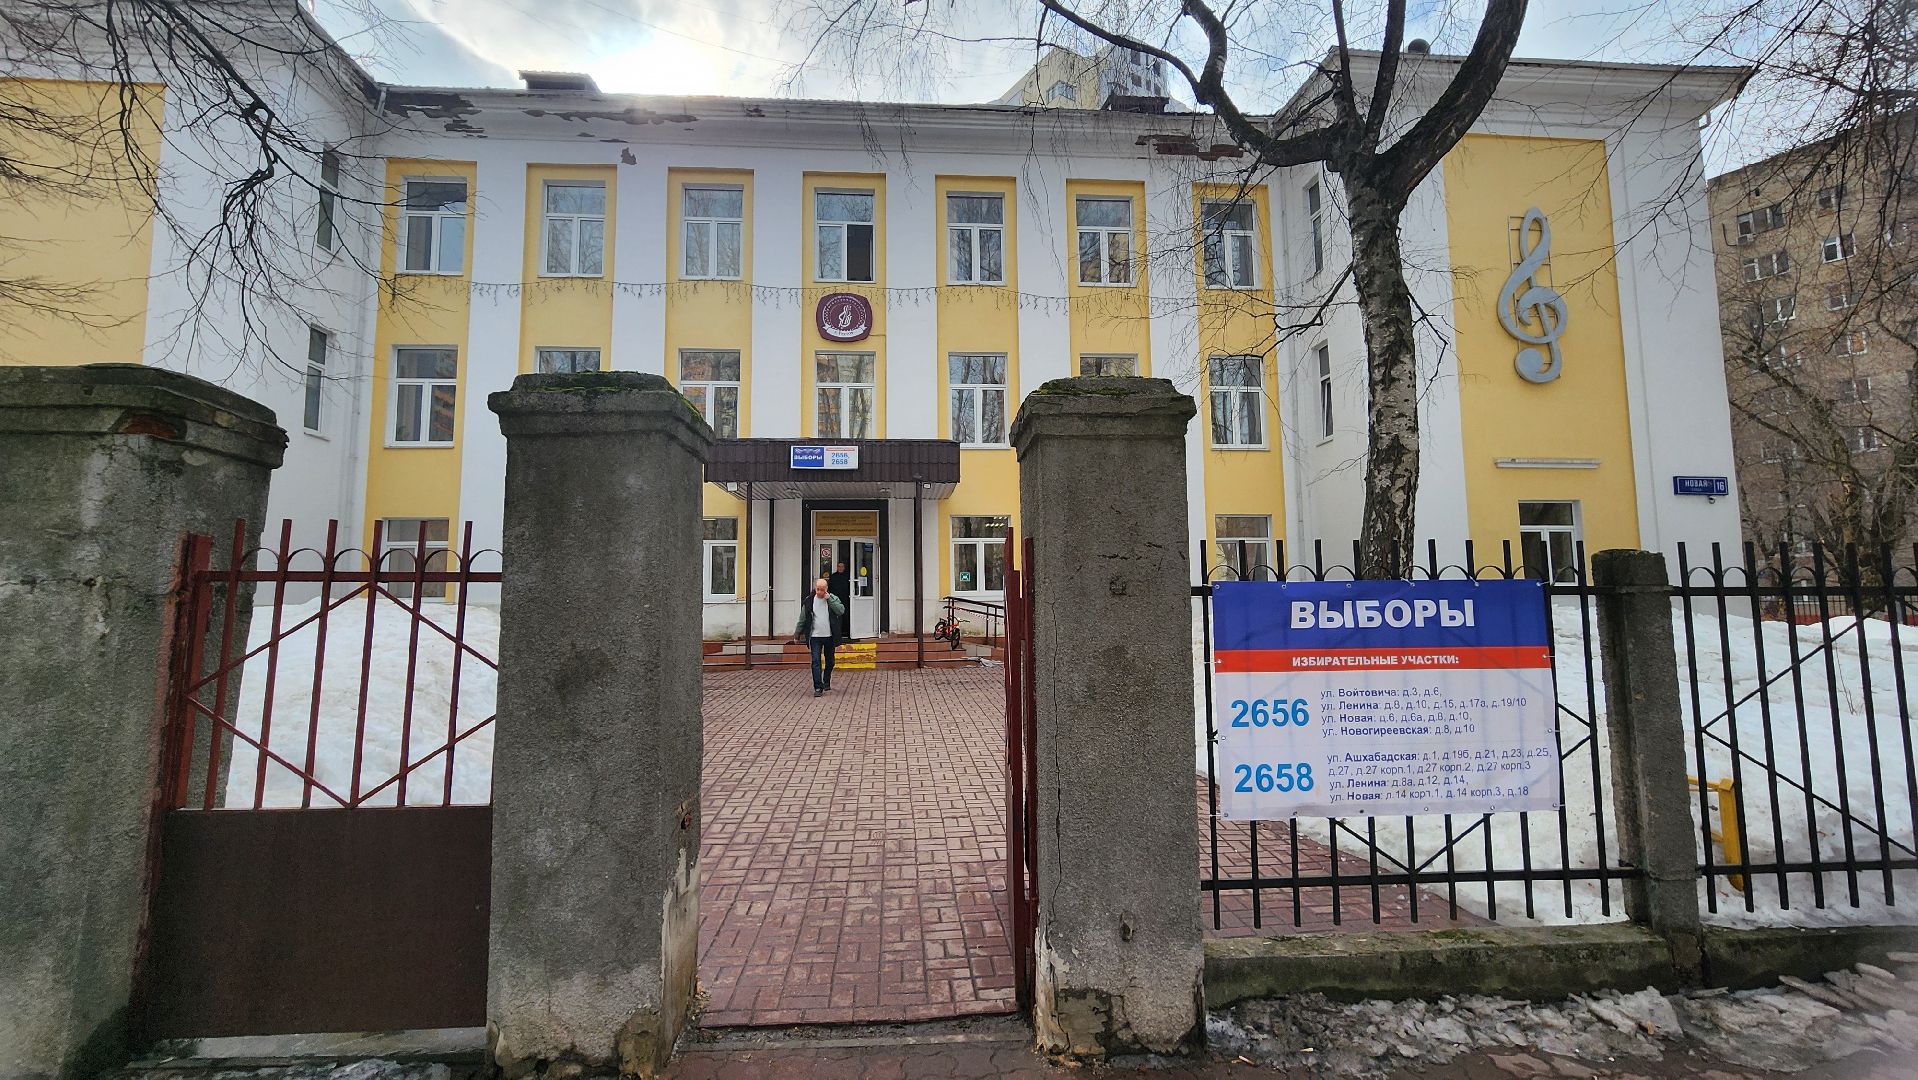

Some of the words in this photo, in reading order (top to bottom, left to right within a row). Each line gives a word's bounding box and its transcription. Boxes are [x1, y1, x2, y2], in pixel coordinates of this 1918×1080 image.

[1716, 482, 1724, 491] 16
[1290, 599, 1475, 629] ВЫБОРЫ
[1292, 656, 1399, 667] ИЗБИРАТЕЛЬНЫЕ
[1401, 655, 1460, 666] УЧАСТКИ:
[1320, 690, 1335, 700] ул.
[1338, 688, 1400, 697] Войтовича:
[1402, 687, 1421, 697] д.3,
[1424, 687, 1442, 697] д.6,
[1320, 703, 1336, 712] ул.
[1384, 700, 1403, 710] д.8,
[1406, 700, 1430, 710] д.10,
[1434, 699, 1457, 709] д.15,
[1460, 699, 1488, 709] д.17а,
[1492, 698, 1527, 708] д.19/10
[1231, 698, 1310, 728] 2656
[1321, 715, 1336, 725] ул.
[1339, 713, 1376, 722] Новая:
[1401, 712, 1425, 722] д.6а,
[1449, 711, 1472, 722] д.10,
[1340, 726, 1432, 737] Новогиреевская:
[1435, 725, 1452, 735] д.8,
[1455, 724, 1475, 734] д.10
[1327, 755, 1342, 764] ул.
[1345, 752, 1420, 762] Ашхабадская:
[1422, 750, 1439, 761] д.1,
[1474, 749, 1499, 759] д.21,
[1527, 748, 1552, 758] д.25,
[1328, 766, 1353, 776] д.27,
[1356, 766, 1377, 775] д.27
[1380, 765, 1415, 776] корп.1,
[1417, 763, 1437, 774] д.27
[1440, 763, 1474, 773] корп.2,
[1477, 762, 1498, 772] д.27
[1501, 761, 1531, 772] корп.3
[1234, 762, 1314, 793] 2658
[1330, 781, 1344, 791] ул.
[1392, 777, 1415, 787] д.8а,
[1418, 775, 1440, 786] д.12,
[1444, 775, 1469, 786] д.14,
[1330, 794, 1344, 804] ул.
[1347, 792, 1382, 800] Новая:
[1446, 788, 1467, 798] д.14
[1470, 786, 1505, 798] корп.3,
[1507, 786, 1529, 797] д.18
